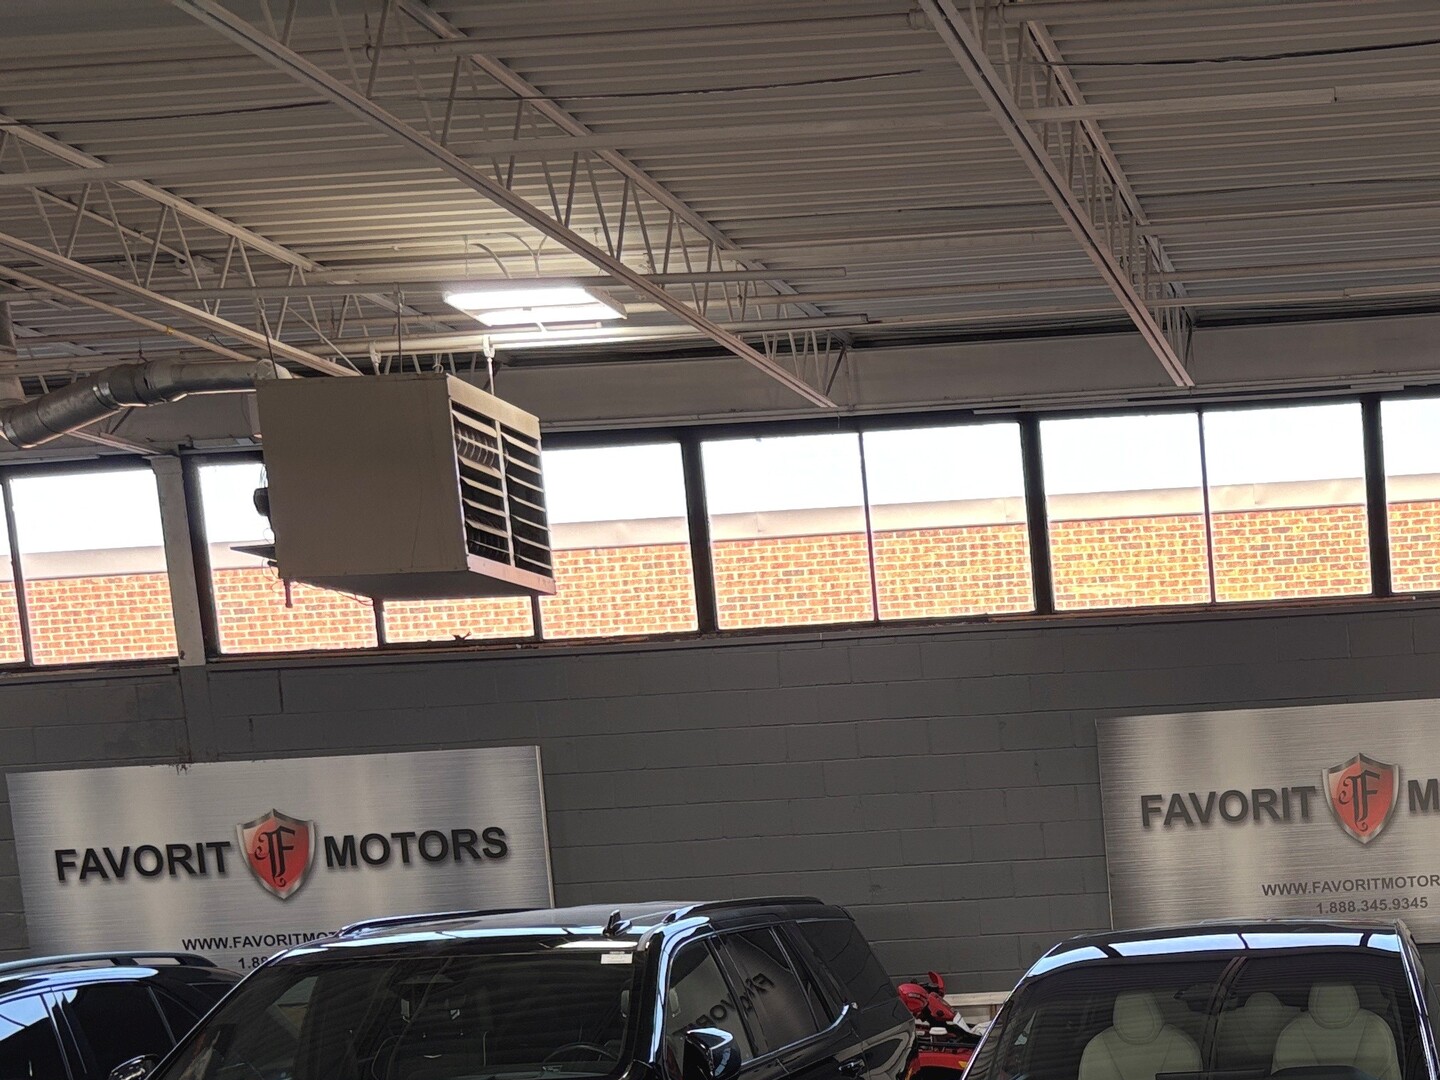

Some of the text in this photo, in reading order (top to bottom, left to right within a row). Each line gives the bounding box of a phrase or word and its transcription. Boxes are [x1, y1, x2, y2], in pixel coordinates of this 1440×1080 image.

[1140, 785, 1317, 828] FAVORIT
[54, 840, 232, 883] FAVORIT
[323, 826, 509, 868] MOTORS
[1316, 896, 1429, 916] 1.888.345.9345
